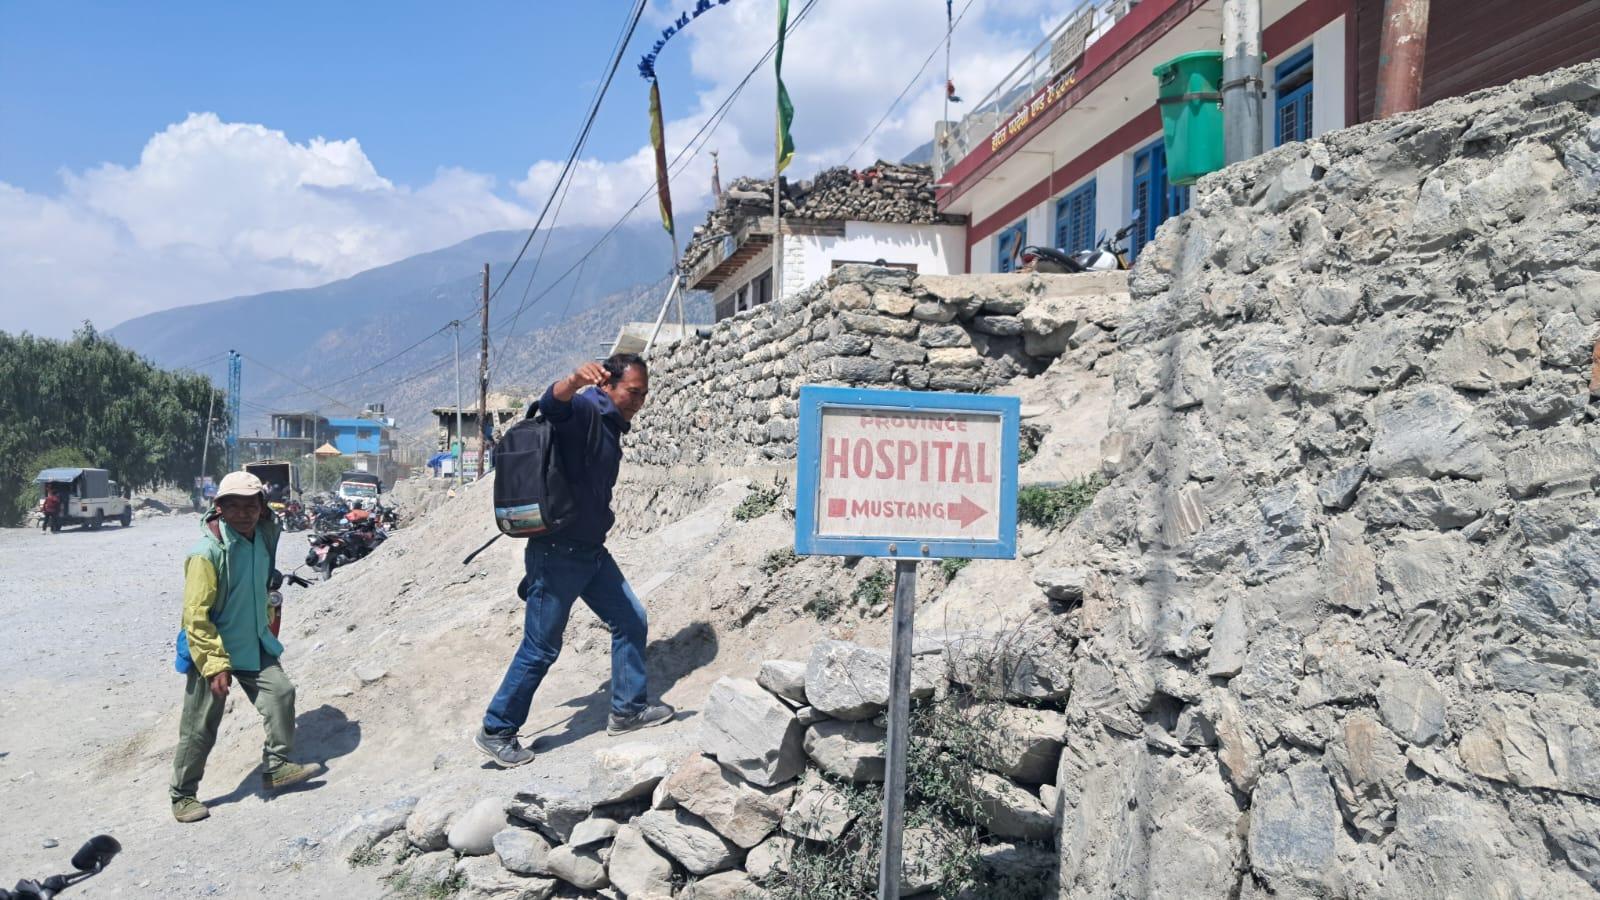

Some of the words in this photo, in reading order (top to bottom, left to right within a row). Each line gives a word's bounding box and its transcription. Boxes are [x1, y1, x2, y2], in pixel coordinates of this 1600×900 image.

[991, 131, 1007, 152] होटल
[860, 414, 968, 432] PROVINCE
[825, 437, 993, 484] HOSPITAL
[851, 499, 945, 520] MUSTANG
